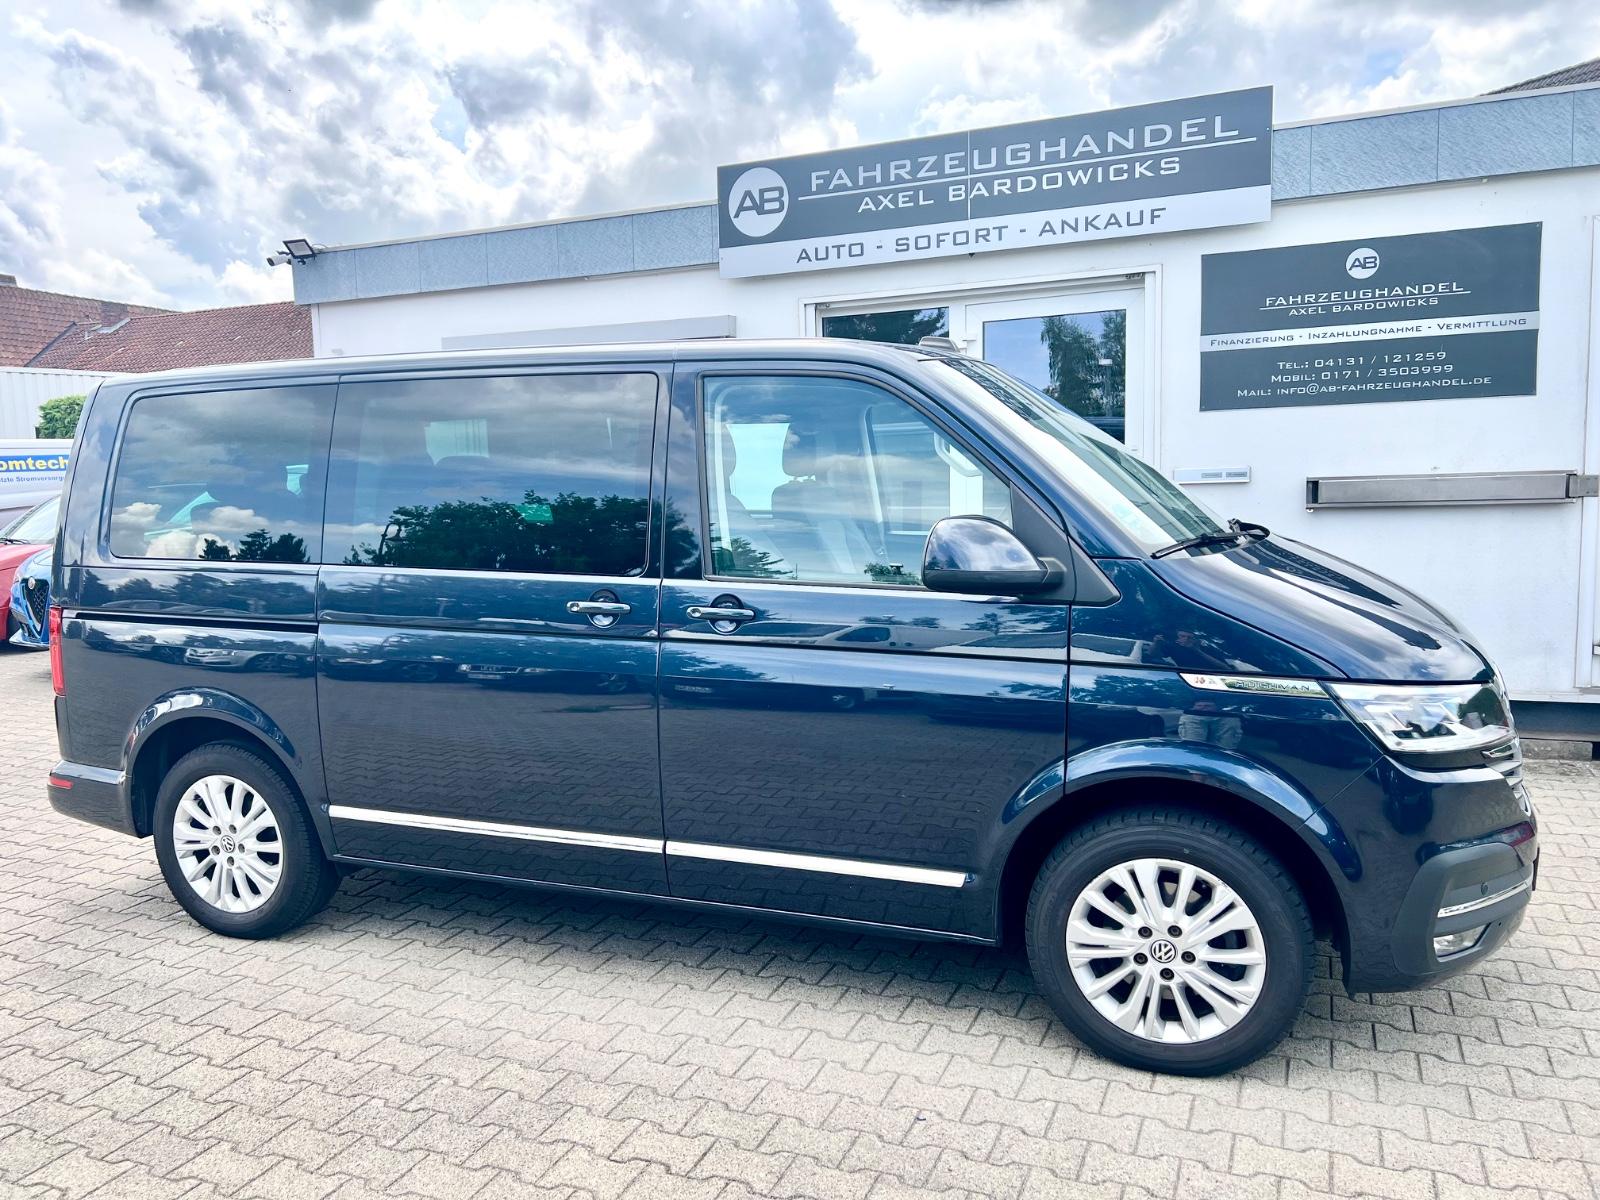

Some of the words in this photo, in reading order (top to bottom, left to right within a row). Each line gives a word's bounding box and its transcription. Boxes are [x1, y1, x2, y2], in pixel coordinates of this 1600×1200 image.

[811, 115, 1239, 192] FAHRZEUGHANDEL
[858, 189, 935, 214] AXEL
[948, 156, 1180, 202] BARDOWICKS
[733, 186, 786, 219] AB
[796, 242, 865, 264] AUTO
[895, 225, 1009, 253] SOFORT
[1038, 207, 1166, 237] ANKAUF
[1349, 256, 1377, 270] AB
[1266, 282, 1464, 306] FAHRZEUGHANDEL
[1288, 306, 1327, 316] AXEL
[1332, 297, 1439, 313] BARDOWICKS
[1314, 356, 1363, 368] 04131
[1384, 351, 1446, 363] 121259
[1321, 370, 1360, 380] 0171
[1378, 364, 1454, 376] 3503999
[0, 456, 69, 471] omtech
